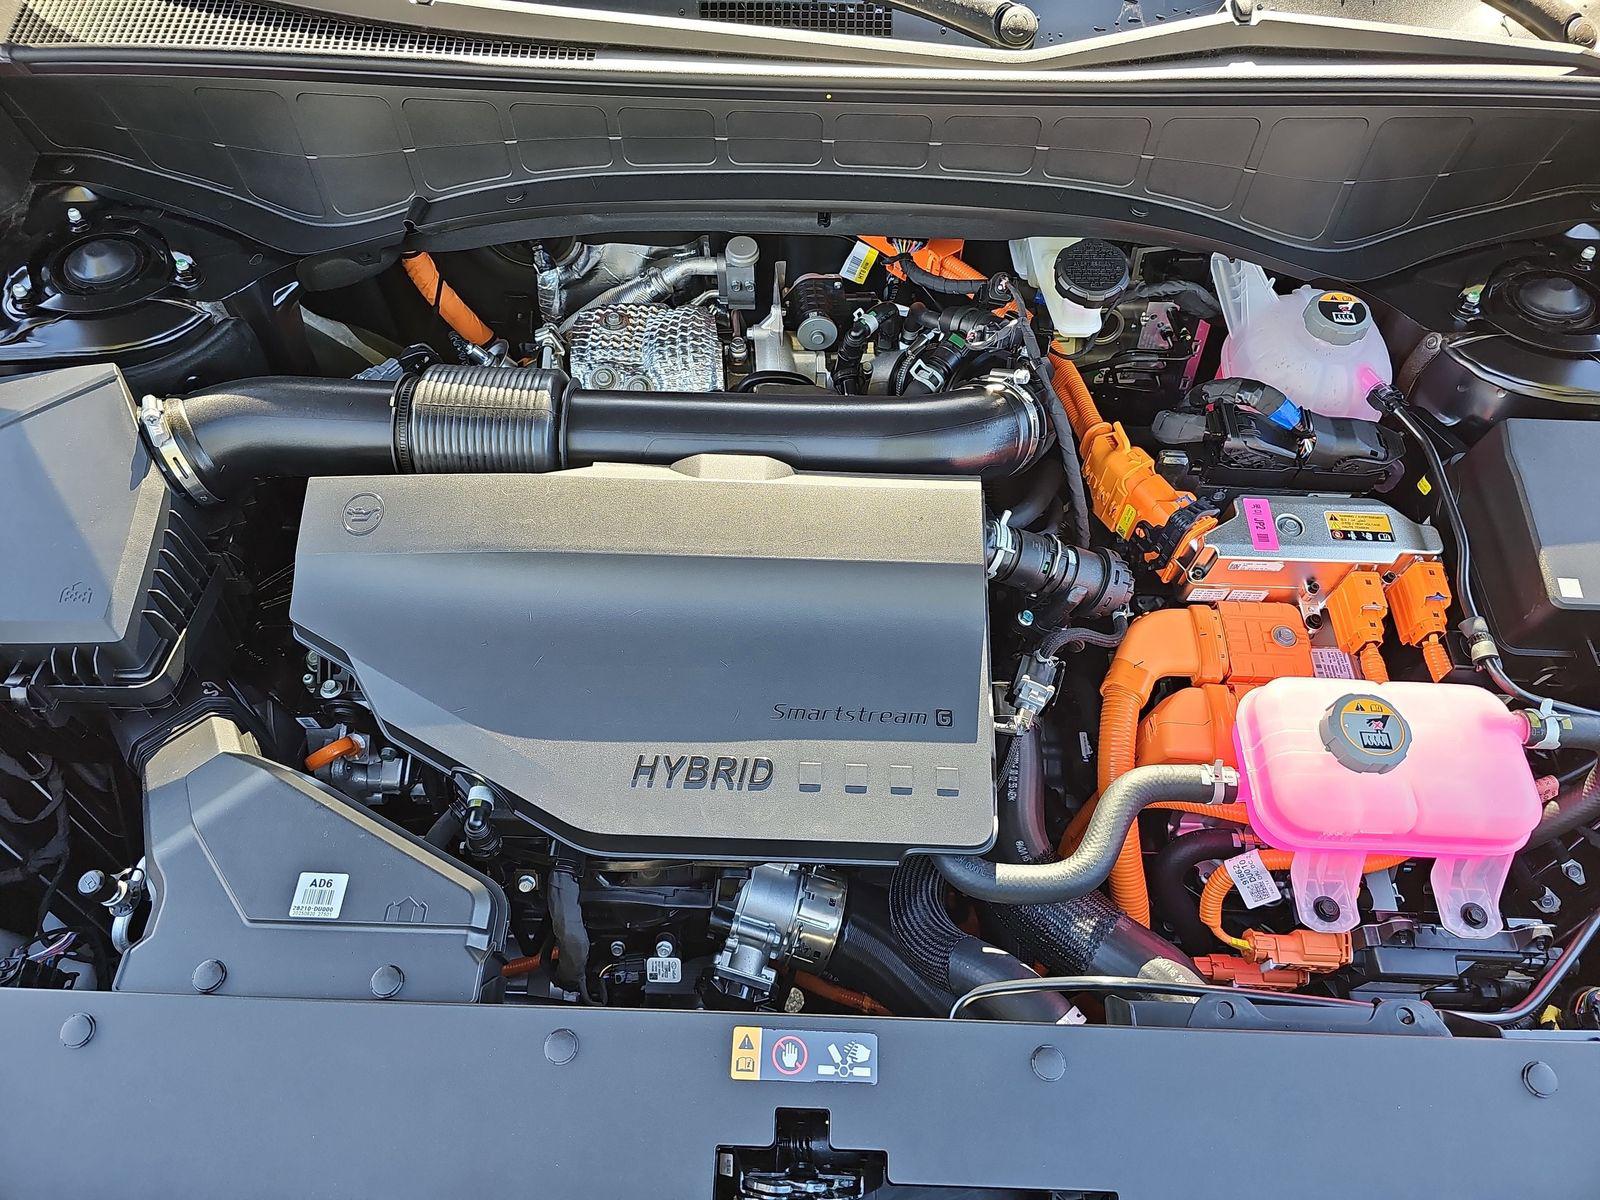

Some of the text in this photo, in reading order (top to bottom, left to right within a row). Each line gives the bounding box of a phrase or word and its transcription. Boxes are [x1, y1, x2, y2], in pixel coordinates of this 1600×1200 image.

[1254, 518, 1266, 530] JP2
[770, 703, 927, 725] Smartstream
[632, 754, 775, 791] HYBRID
[1233, 864, 1250, 886] 91662
[1239, 860, 1257, 883] DU010
[309, 879, 333, 888] AD6
